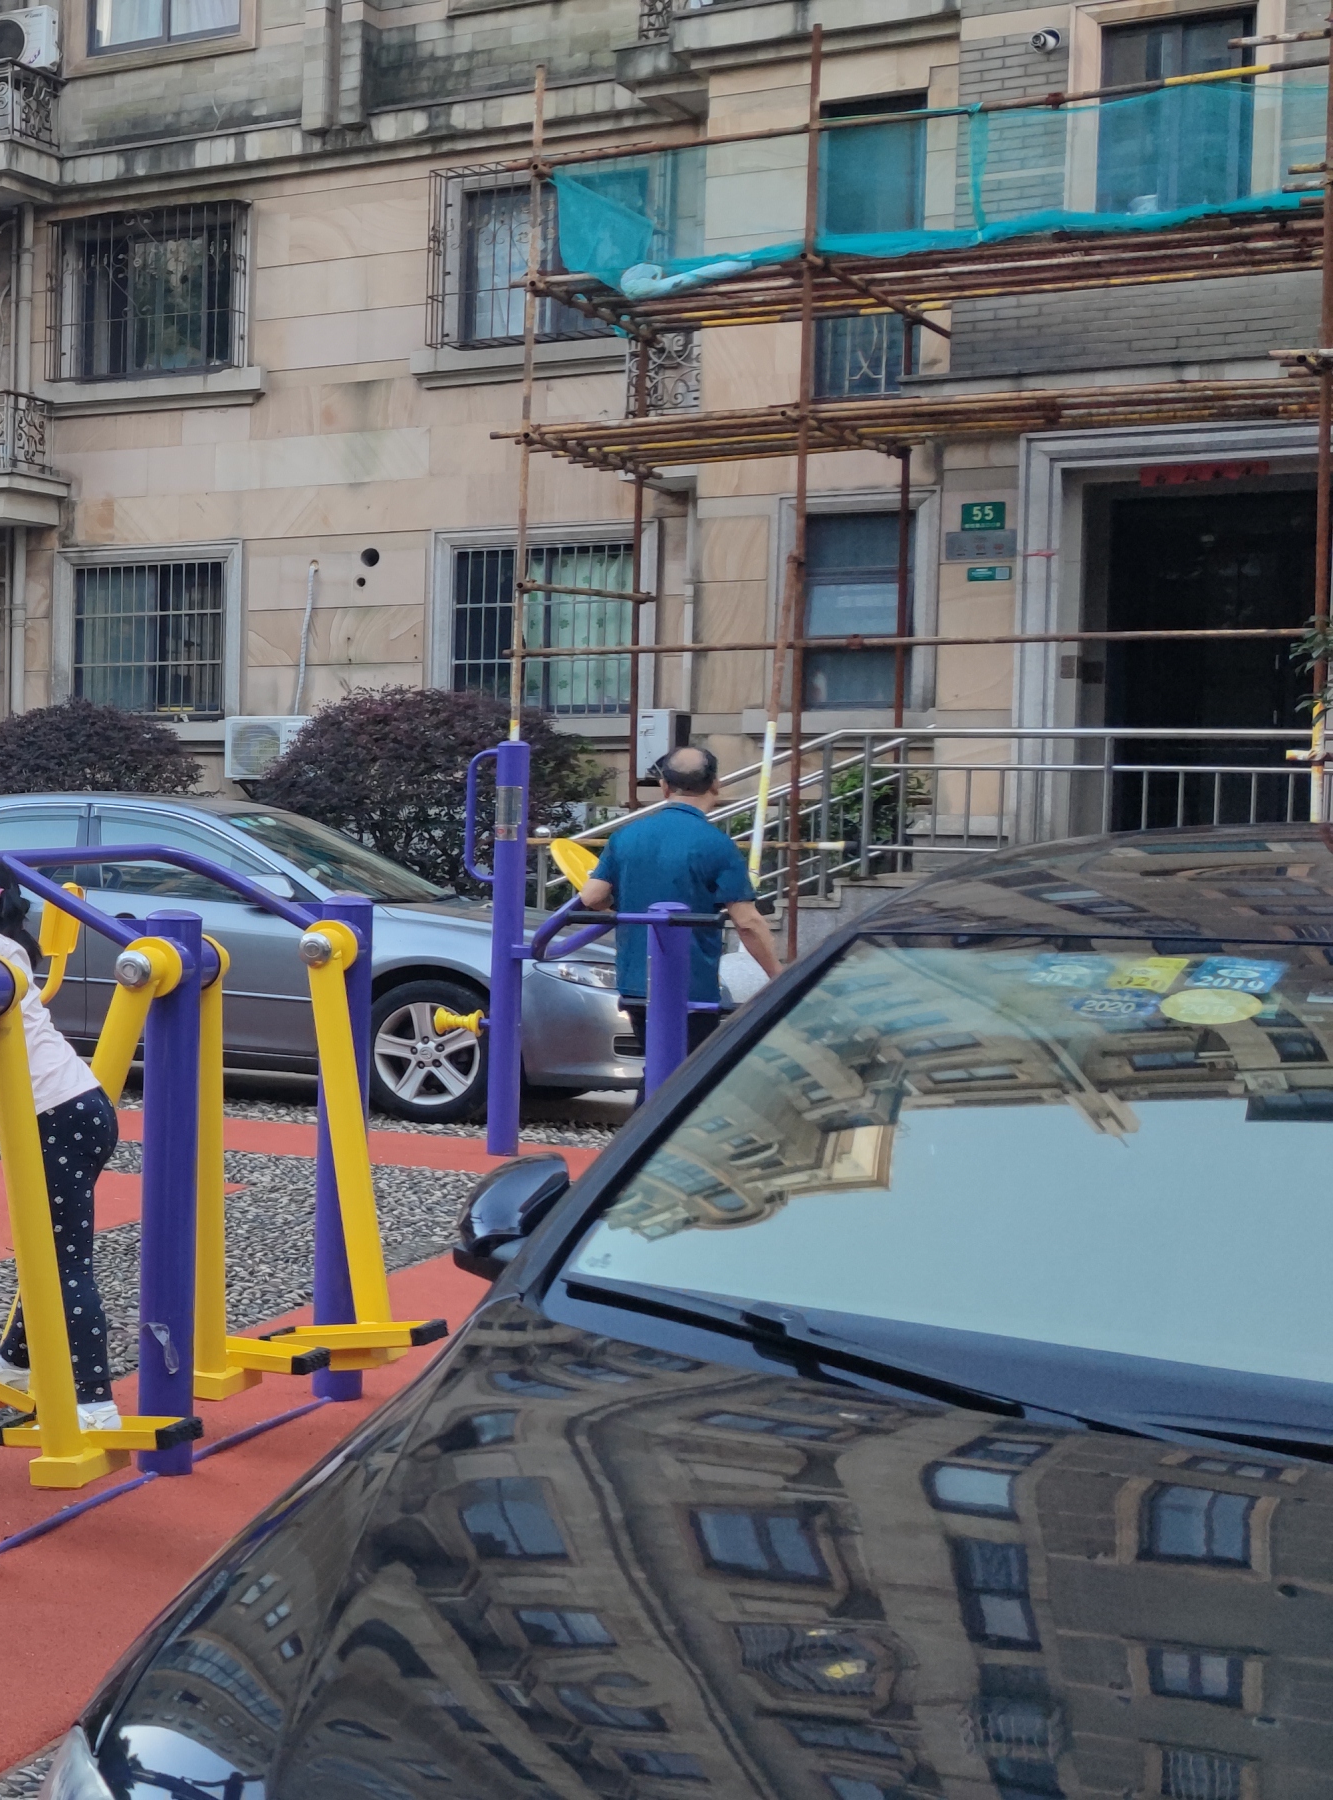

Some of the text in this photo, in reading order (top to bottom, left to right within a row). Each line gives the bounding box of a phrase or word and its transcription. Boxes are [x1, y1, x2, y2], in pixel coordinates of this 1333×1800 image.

[972, 505, 994, 520] 55
[1193, 975, 1266, 991] 2019
[1082, 999, 1135, 1014] 2020
